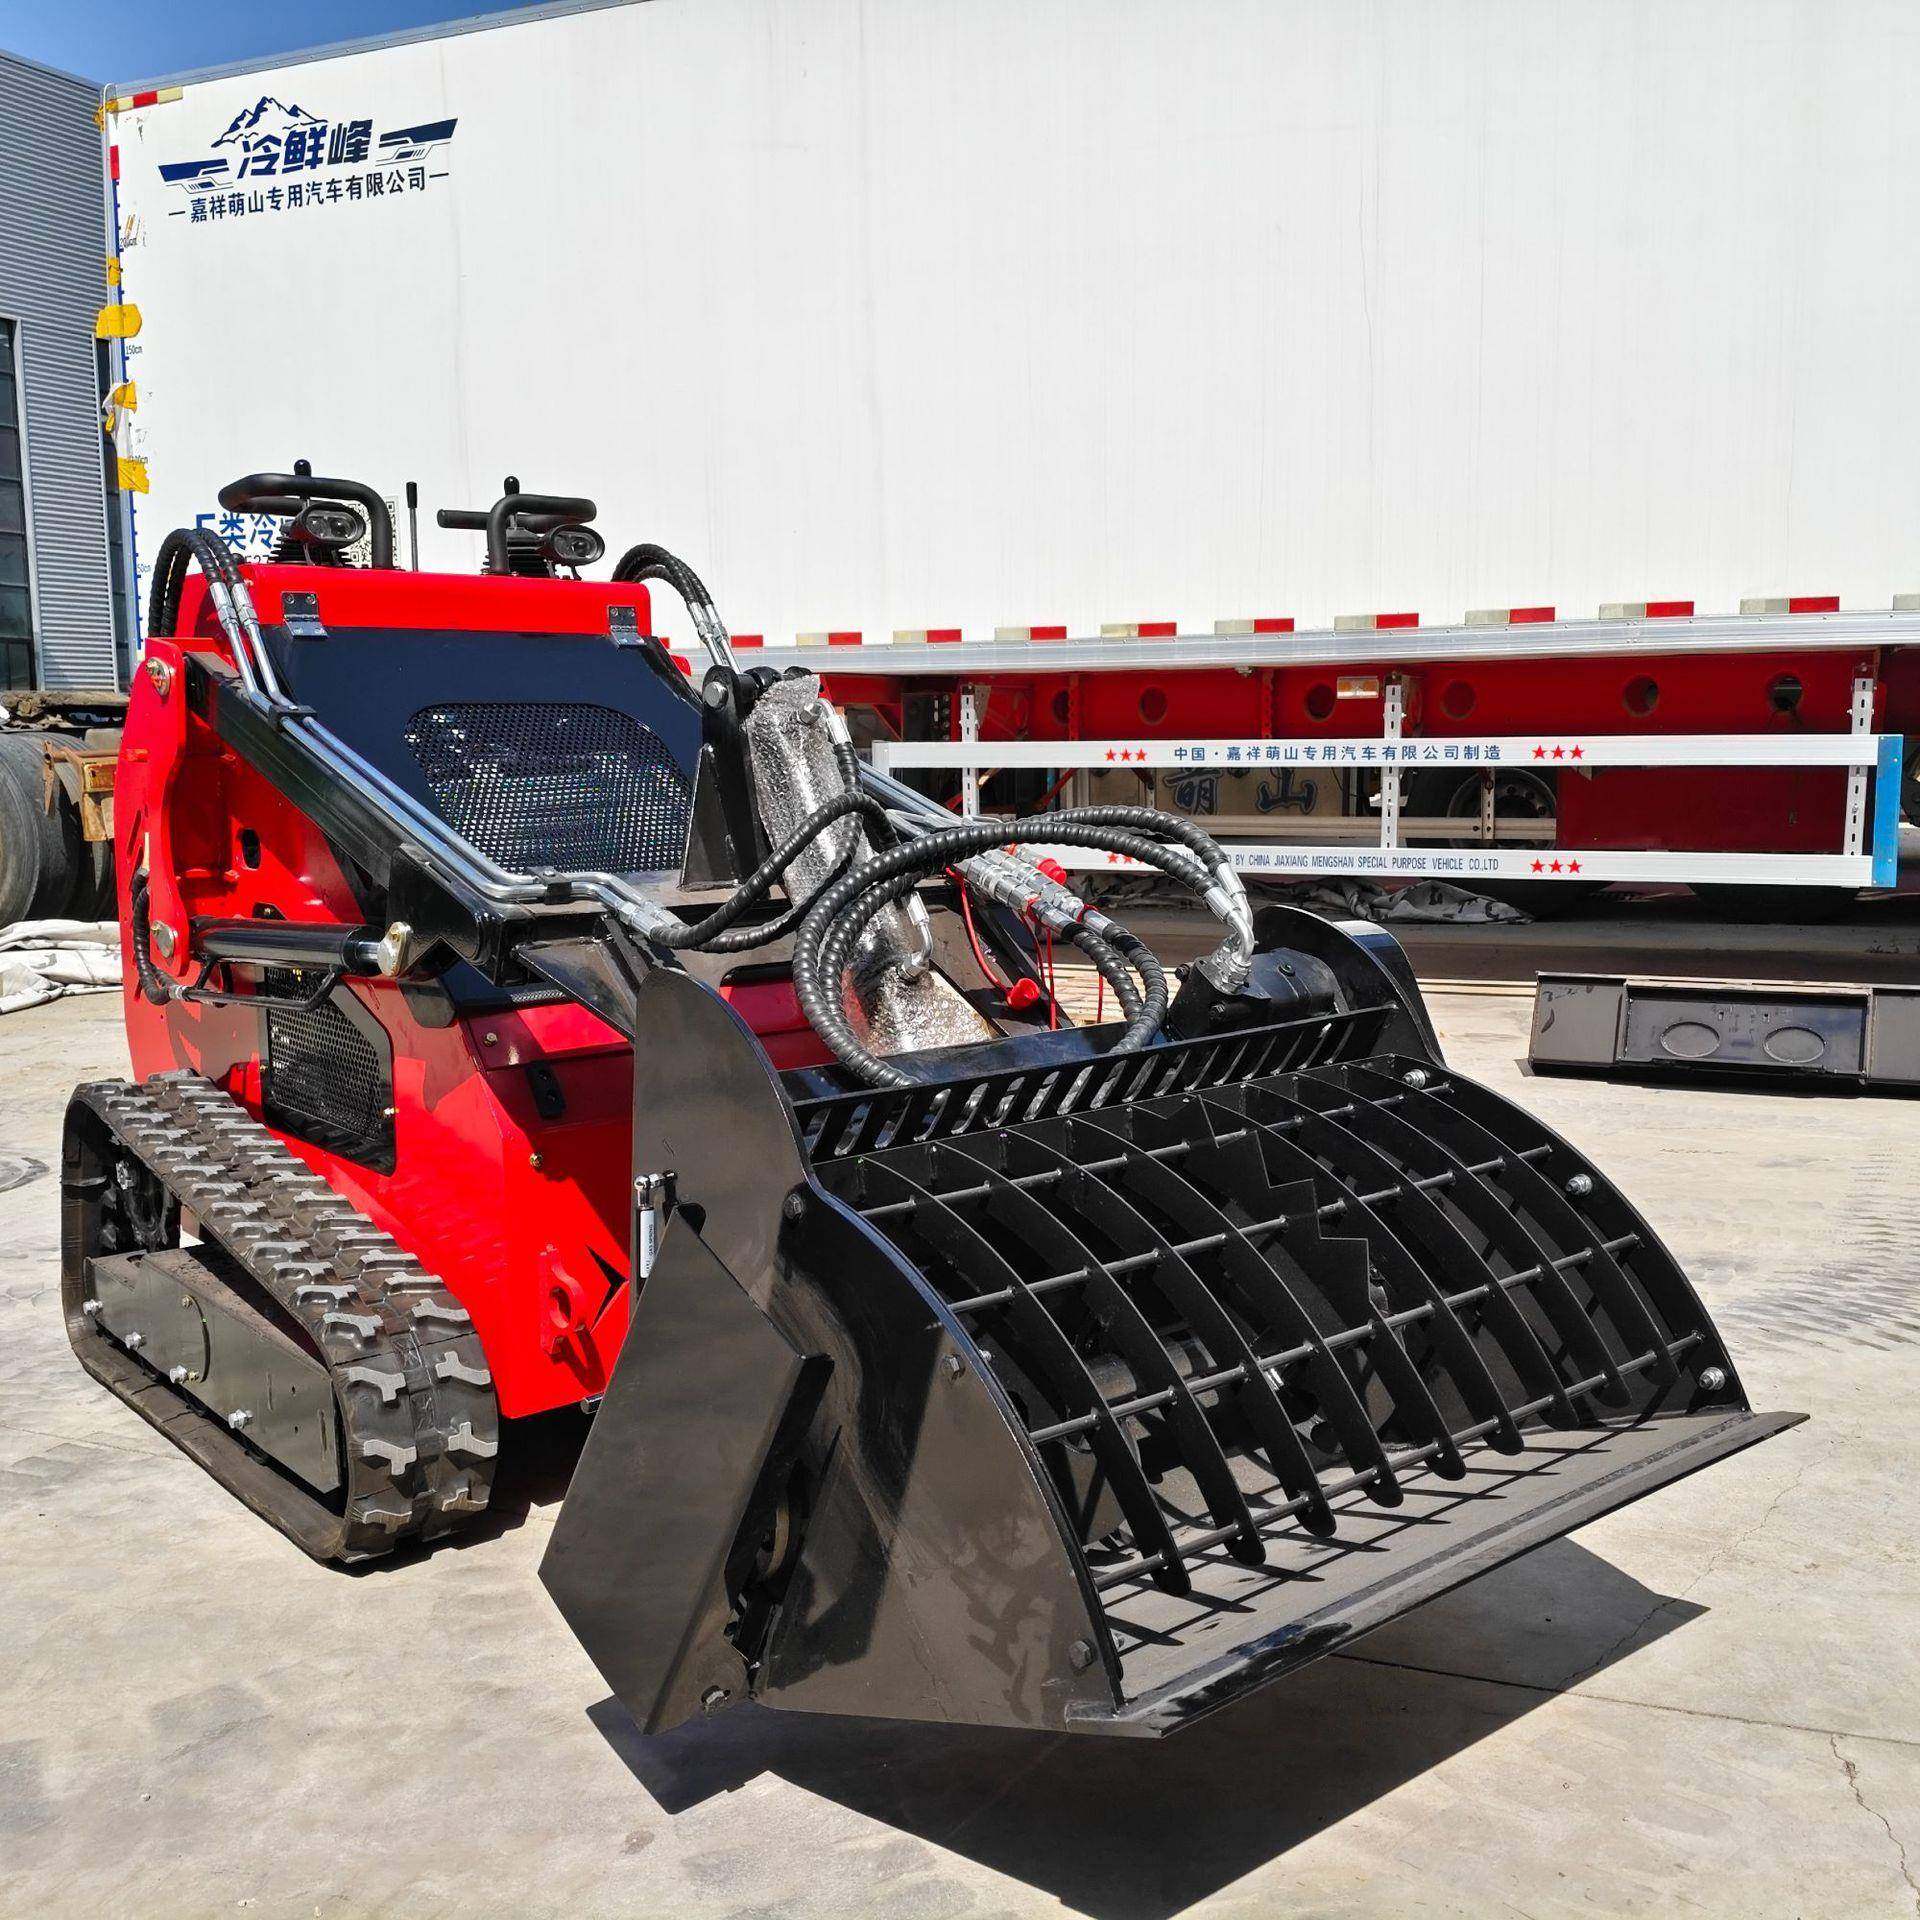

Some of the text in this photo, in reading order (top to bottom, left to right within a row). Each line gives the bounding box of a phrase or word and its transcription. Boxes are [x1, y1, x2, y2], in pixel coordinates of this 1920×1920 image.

[237, 119, 373, 179] 冷鲜峰
[190, 166, 425, 223] 嘉祥萌山专用汽车有限公司
[126, 345, 143, 355] 150cm
[1235, 854, 1245, 865] BY
[1249, 854, 1270, 866] CHINA
[1274, 855, 1308, 867] JIAXIANG
[1311, 855, 1354, 868] MENGSHAN
[1358, 856, 1388, 869] SPECIAL
[1392, 857, 1427, 870] PURPOSE
[1433, 857, 1464, 870] VEHICLE
